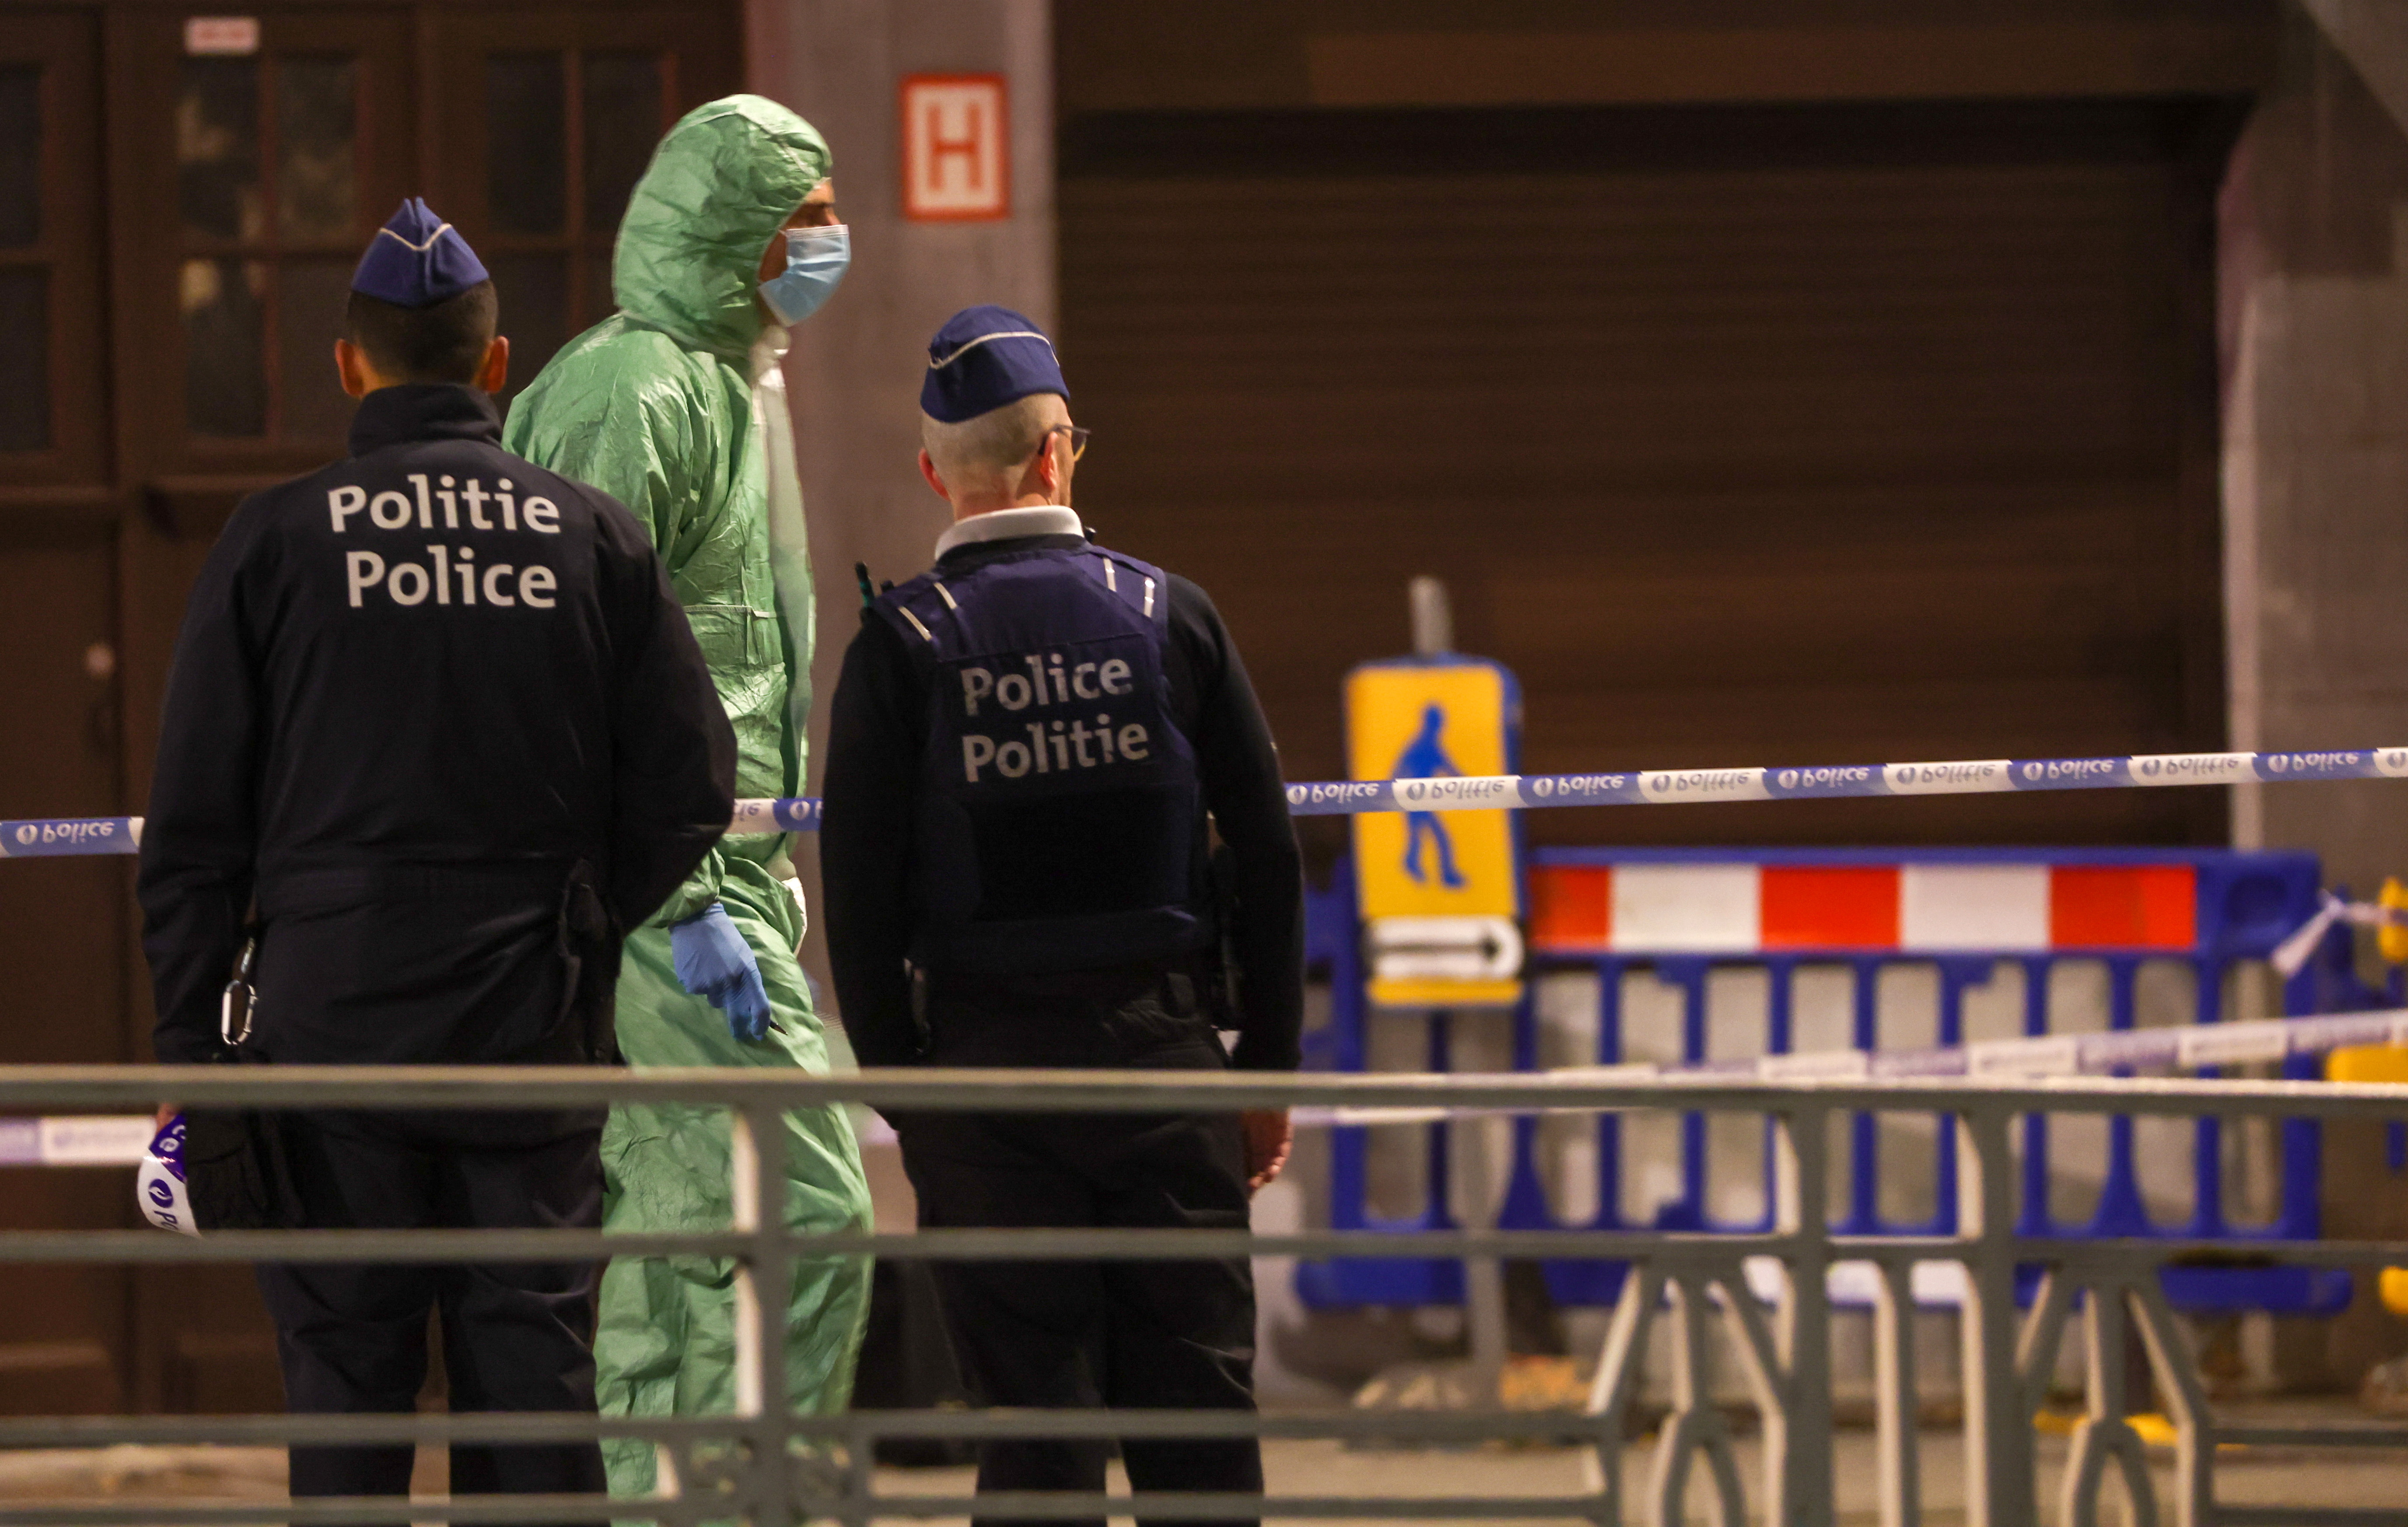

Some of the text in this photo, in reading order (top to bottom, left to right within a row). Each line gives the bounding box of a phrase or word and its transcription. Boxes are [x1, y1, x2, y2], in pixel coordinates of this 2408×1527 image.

[926, 101, 982, 192] H
[327, 474, 561, 533] Politie
[346, 544, 557, 608] Police
[961, 653, 1134, 716] Police
[962, 713, 1149, 783] Politie
